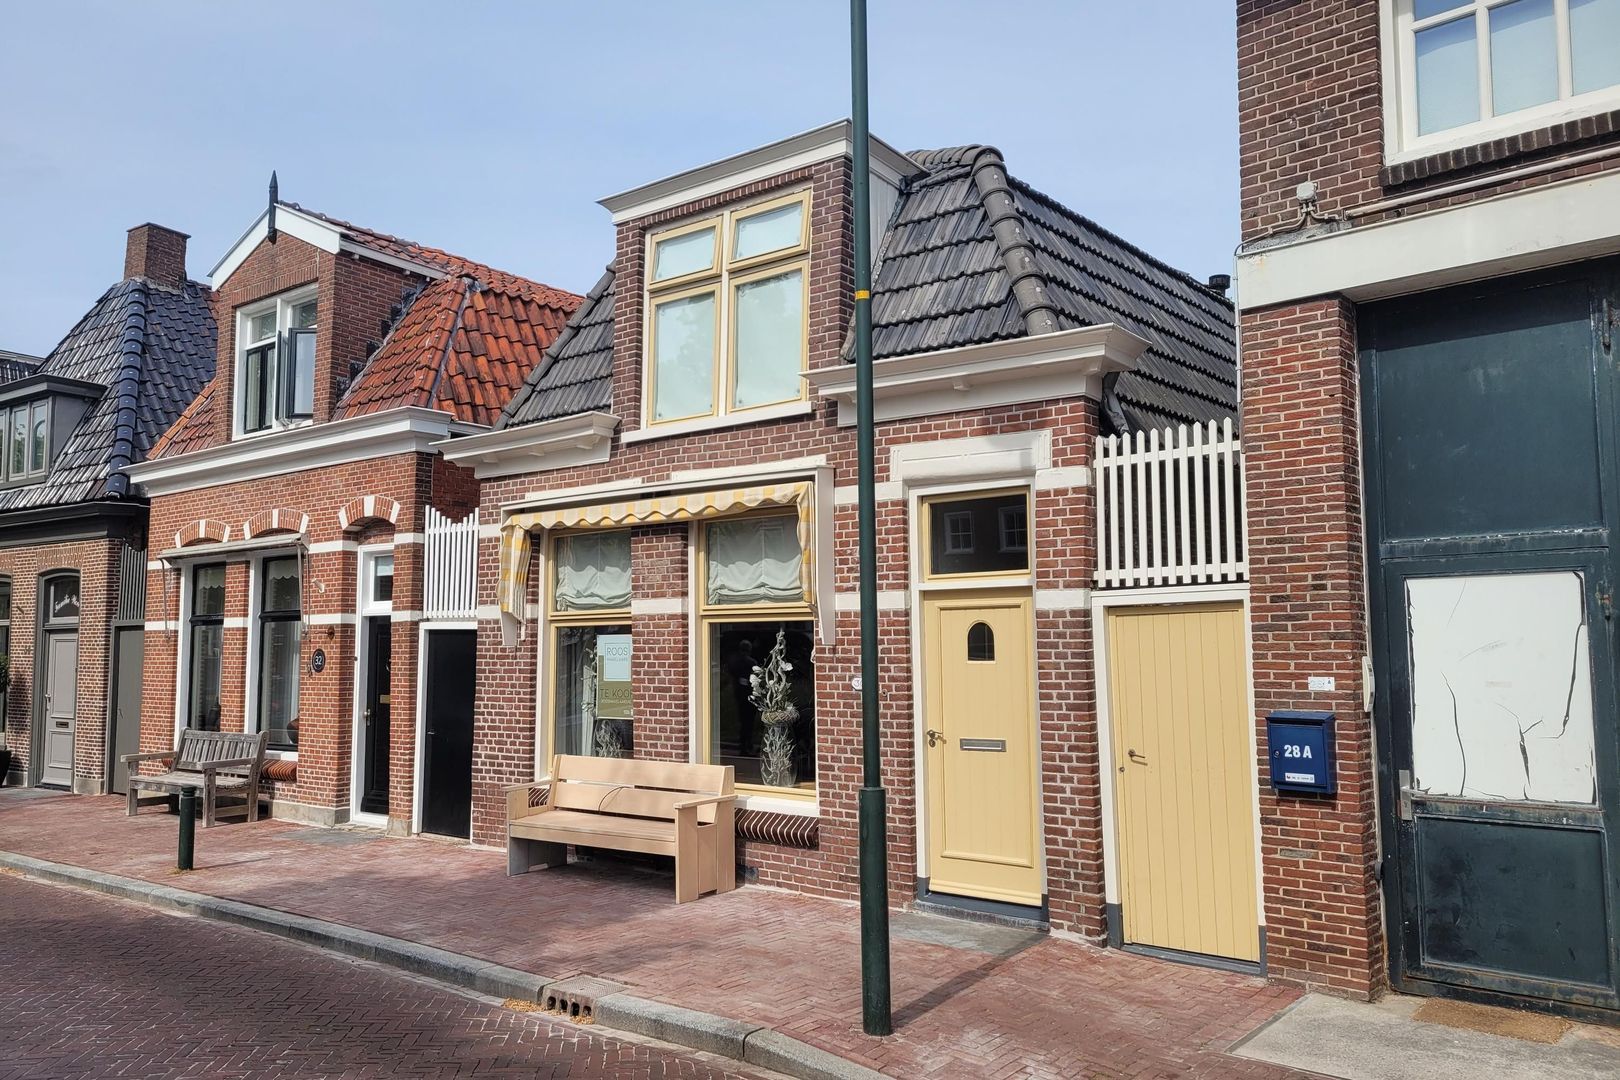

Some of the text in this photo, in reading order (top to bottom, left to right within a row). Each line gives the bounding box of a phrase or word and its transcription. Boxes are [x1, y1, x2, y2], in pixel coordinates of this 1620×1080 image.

[607, 647, 628, 656] ROOS
[314, 655, 323, 665] 32
[600, 688, 609, 698] TE
[1283, 744, 1312, 758] 28 A
